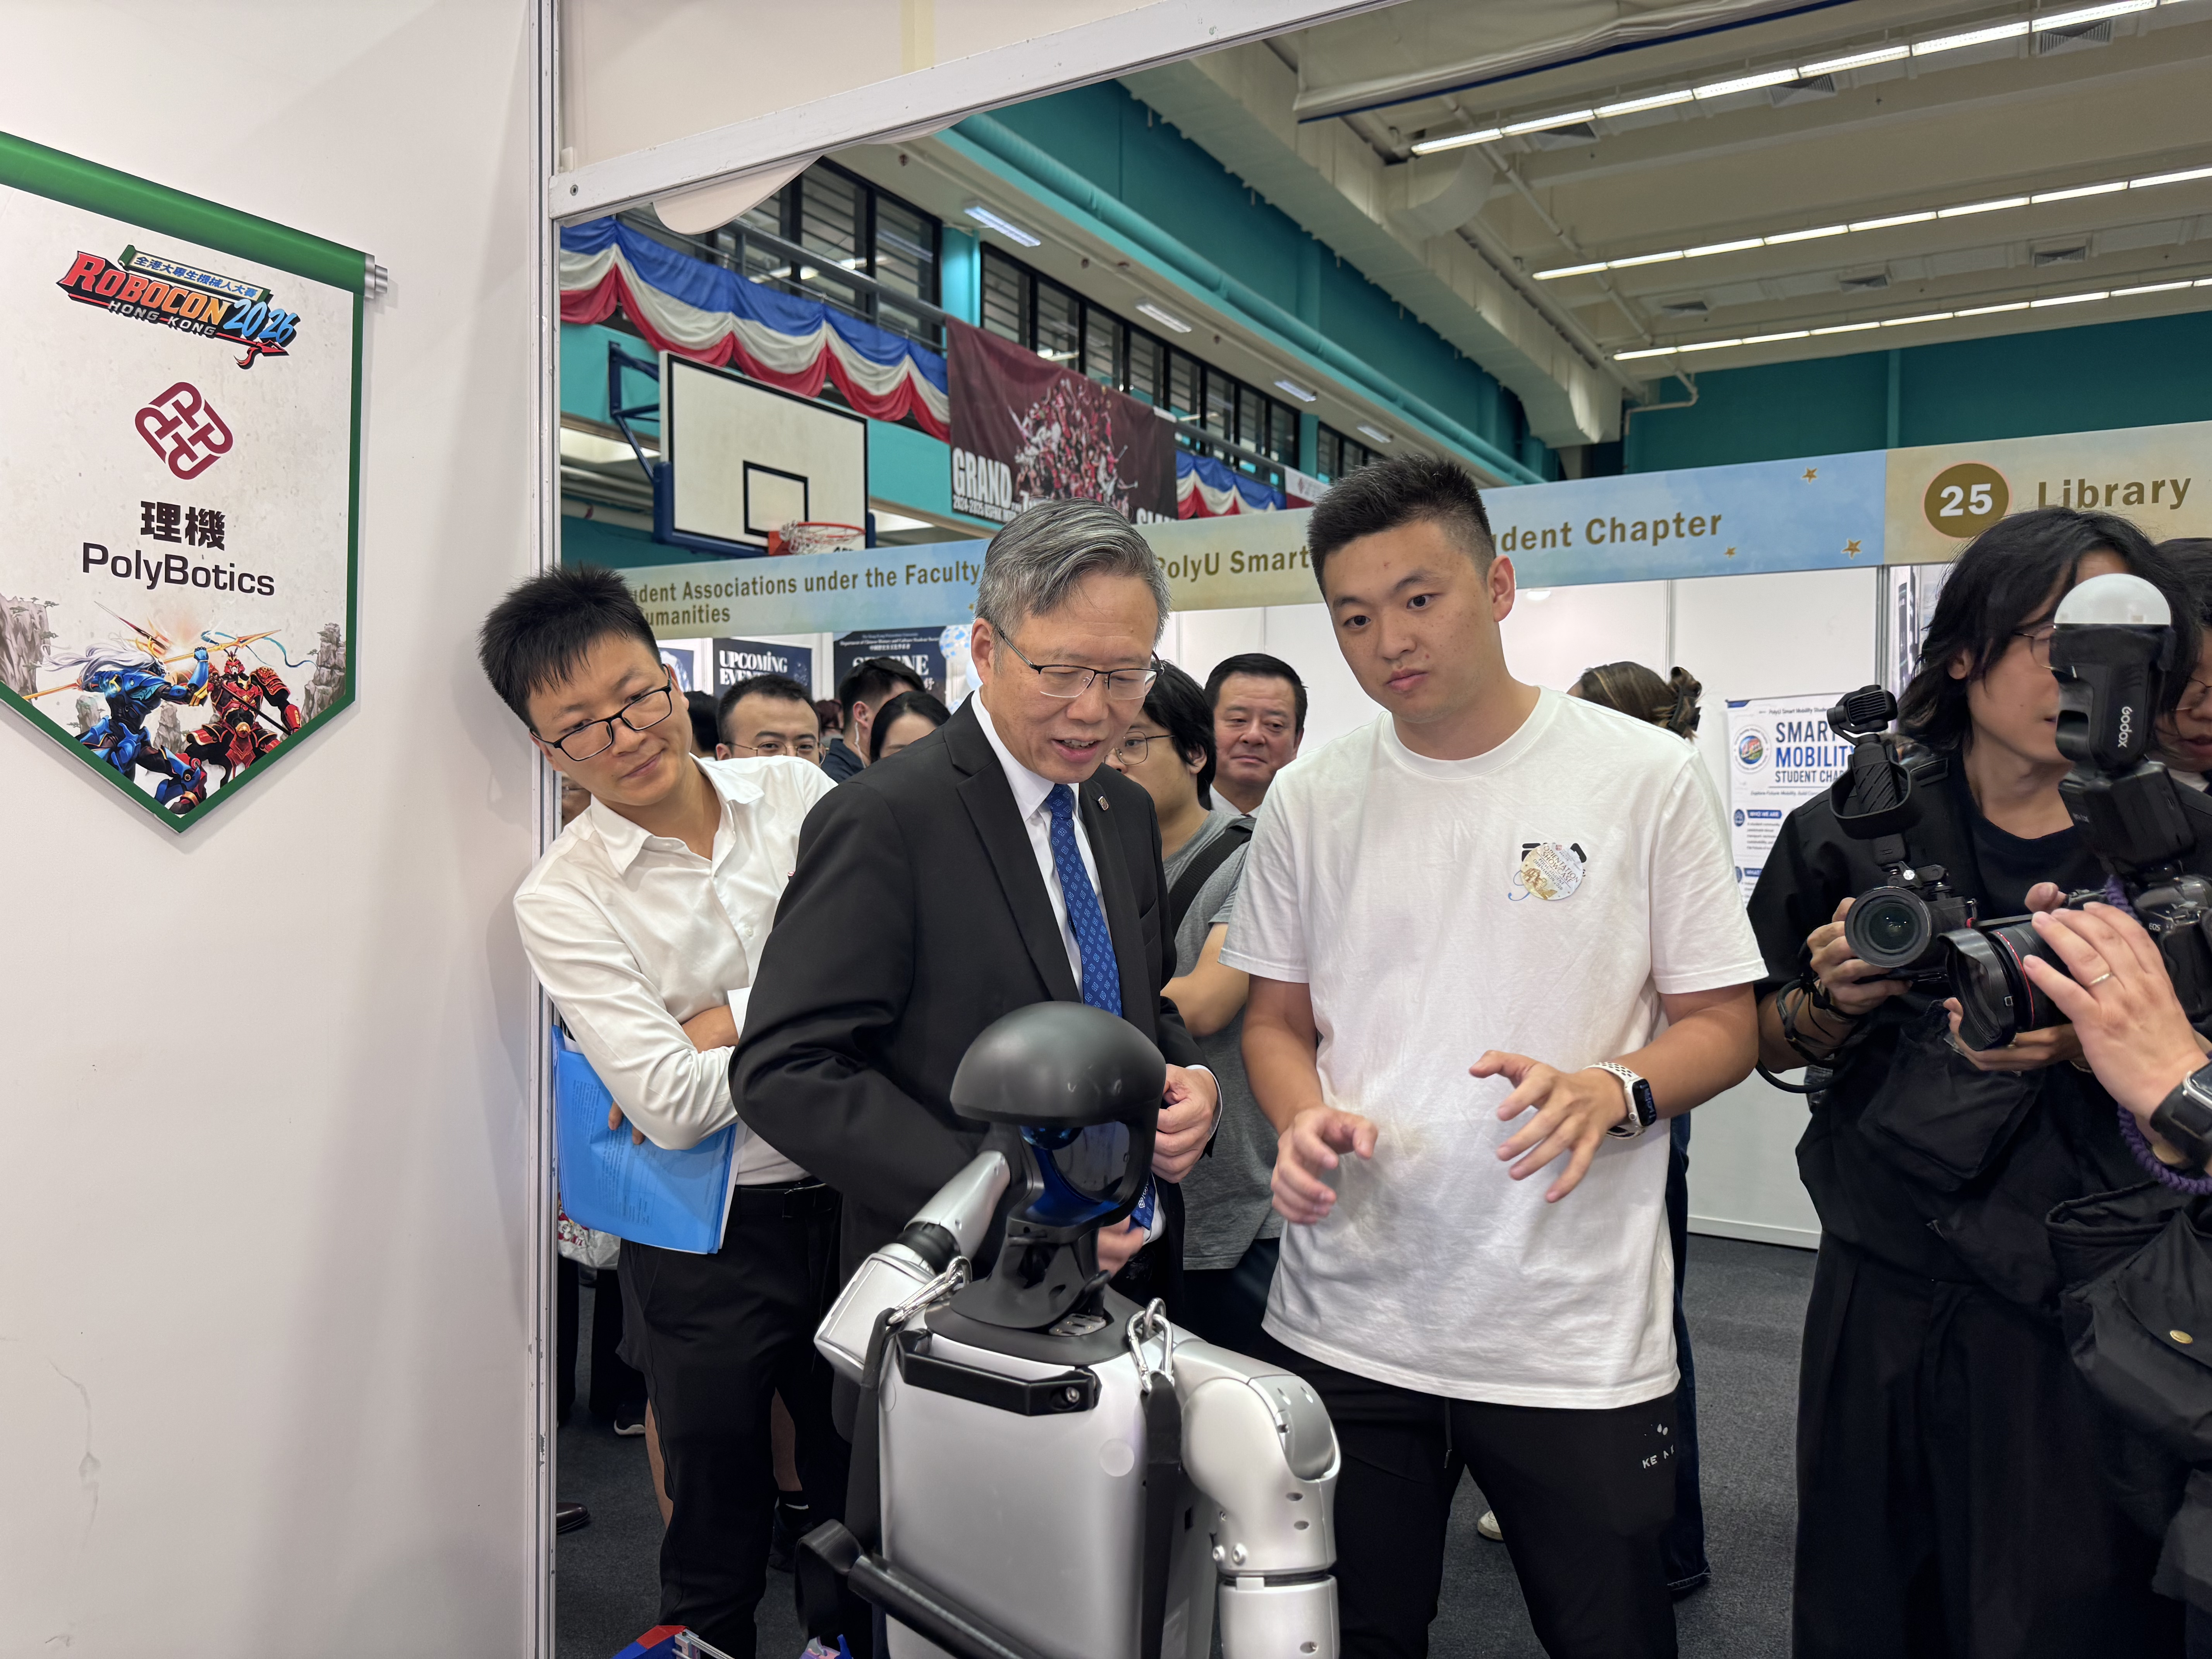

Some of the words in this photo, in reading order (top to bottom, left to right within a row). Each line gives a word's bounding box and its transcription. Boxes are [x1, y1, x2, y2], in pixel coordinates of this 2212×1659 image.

[60, 251, 234, 325] ROBOCON
[223, 299, 297, 343] 2026
[108, 300, 160, 321] HONG
[167, 316, 216, 335] KONG
[952, 447, 1012, 510] GRAND
[1939, 483, 1993, 517] 25
[2038, 477, 2191, 510] Library
[141, 500, 226, 551] 理機
[1230, 546, 1309, 574] Smart
[1585, 512, 1722, 546] Chapter
[82, 542, 275, 596] PolyBotics
[683, 576, 797, 601] Associations
[805, 570, 858, 592] under
[866, 567, 897, 588] the
[905, 561, 980, 585] Faculty
[2118, 706, 2133, 748] Godox
[1775, 770, 1817, 783] STUDENT
[1541, 852, 1573, 883] SHOWCASE
[2149, 923, 2161, 932] EOS
